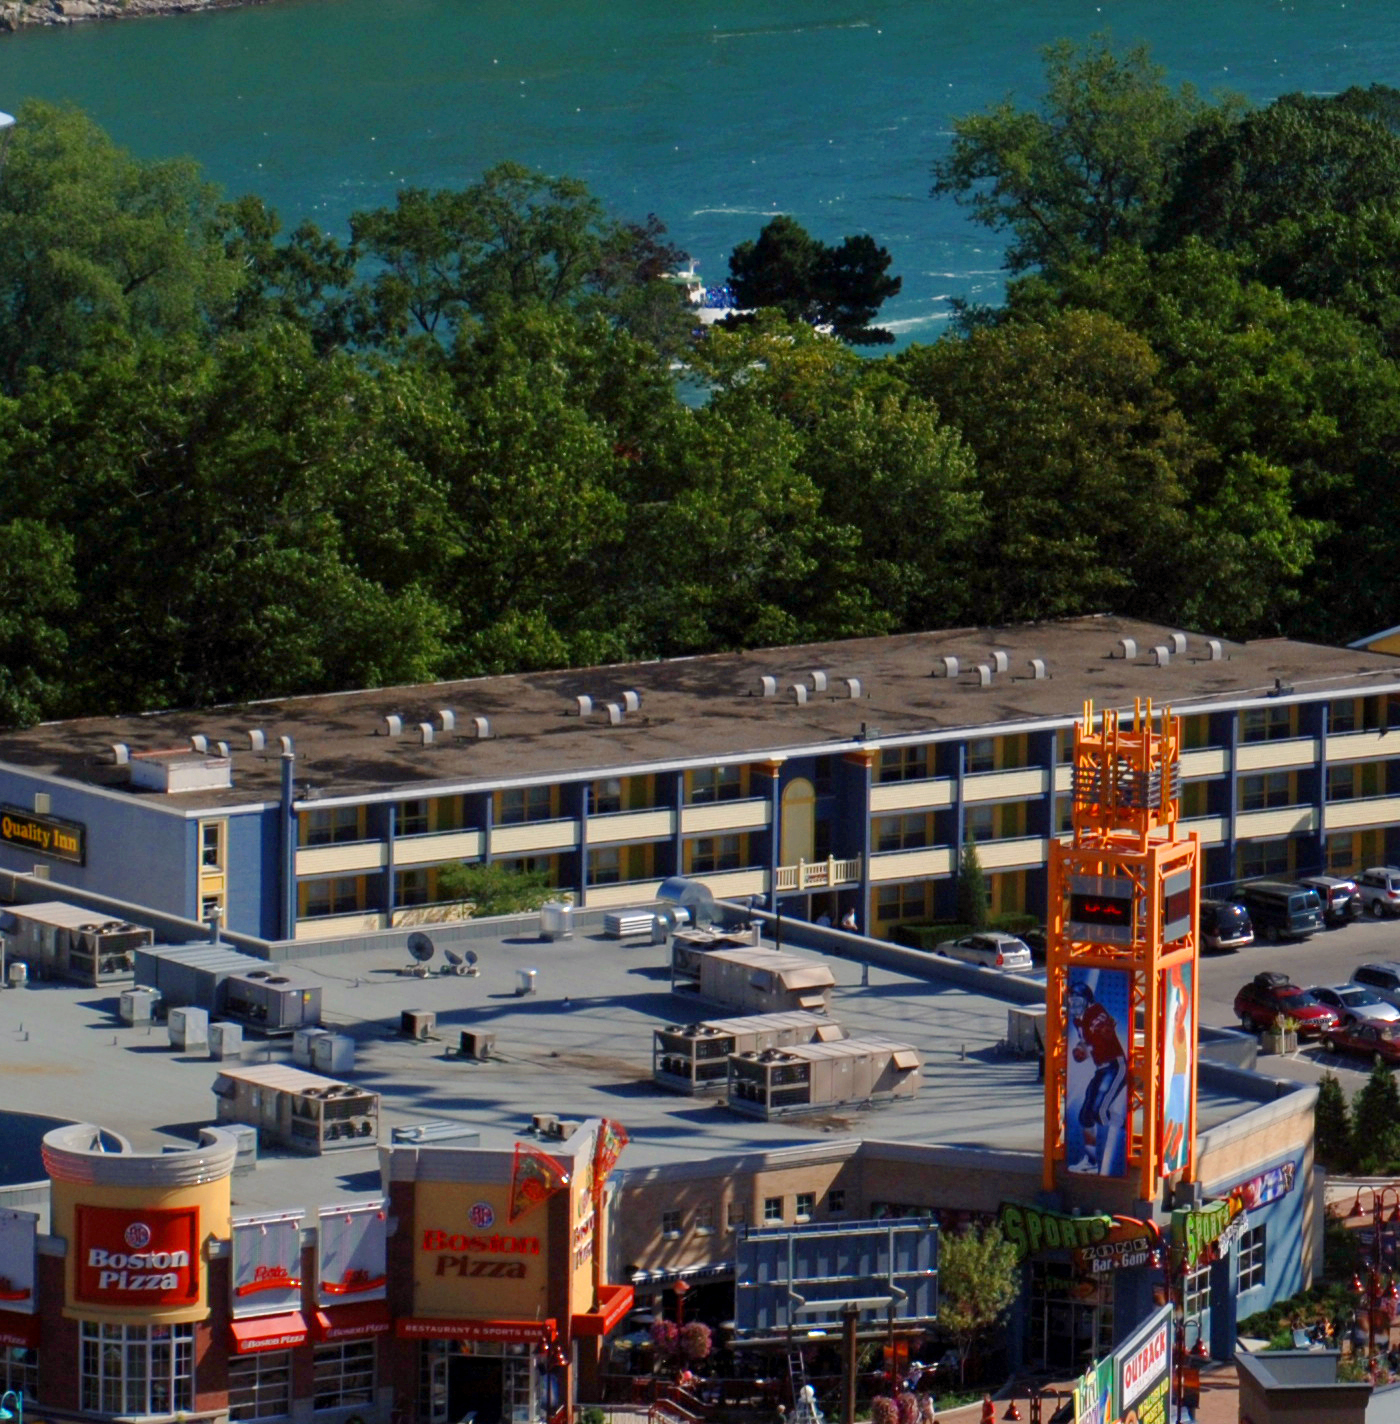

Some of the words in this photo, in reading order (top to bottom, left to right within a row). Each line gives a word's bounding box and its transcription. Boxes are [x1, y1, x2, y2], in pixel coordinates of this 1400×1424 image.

[2, 816, 50, 848] Quality
[53, 829, 78, 852] Inn
[423, 1230, 540, 1255] Boston
[1001, 1207, 1107, 1261] SPORTS
[88, 1248, 189, 1269] Boston
[435, 1254, 527, 1279] Pizza
[1092, 1258, 1112, 1273] Bar
[98, 1270, 179, 1290] Pizza
[248, 1338, 280, 1349] Boston
[280, 1334, 305, 1345] Pizza
[405, 1324, 470, 1334] RESTAURANT
[483, 1326, 521, 1336] SPORTS
[1125, 1331, 1165, 1389] OUTBACK
